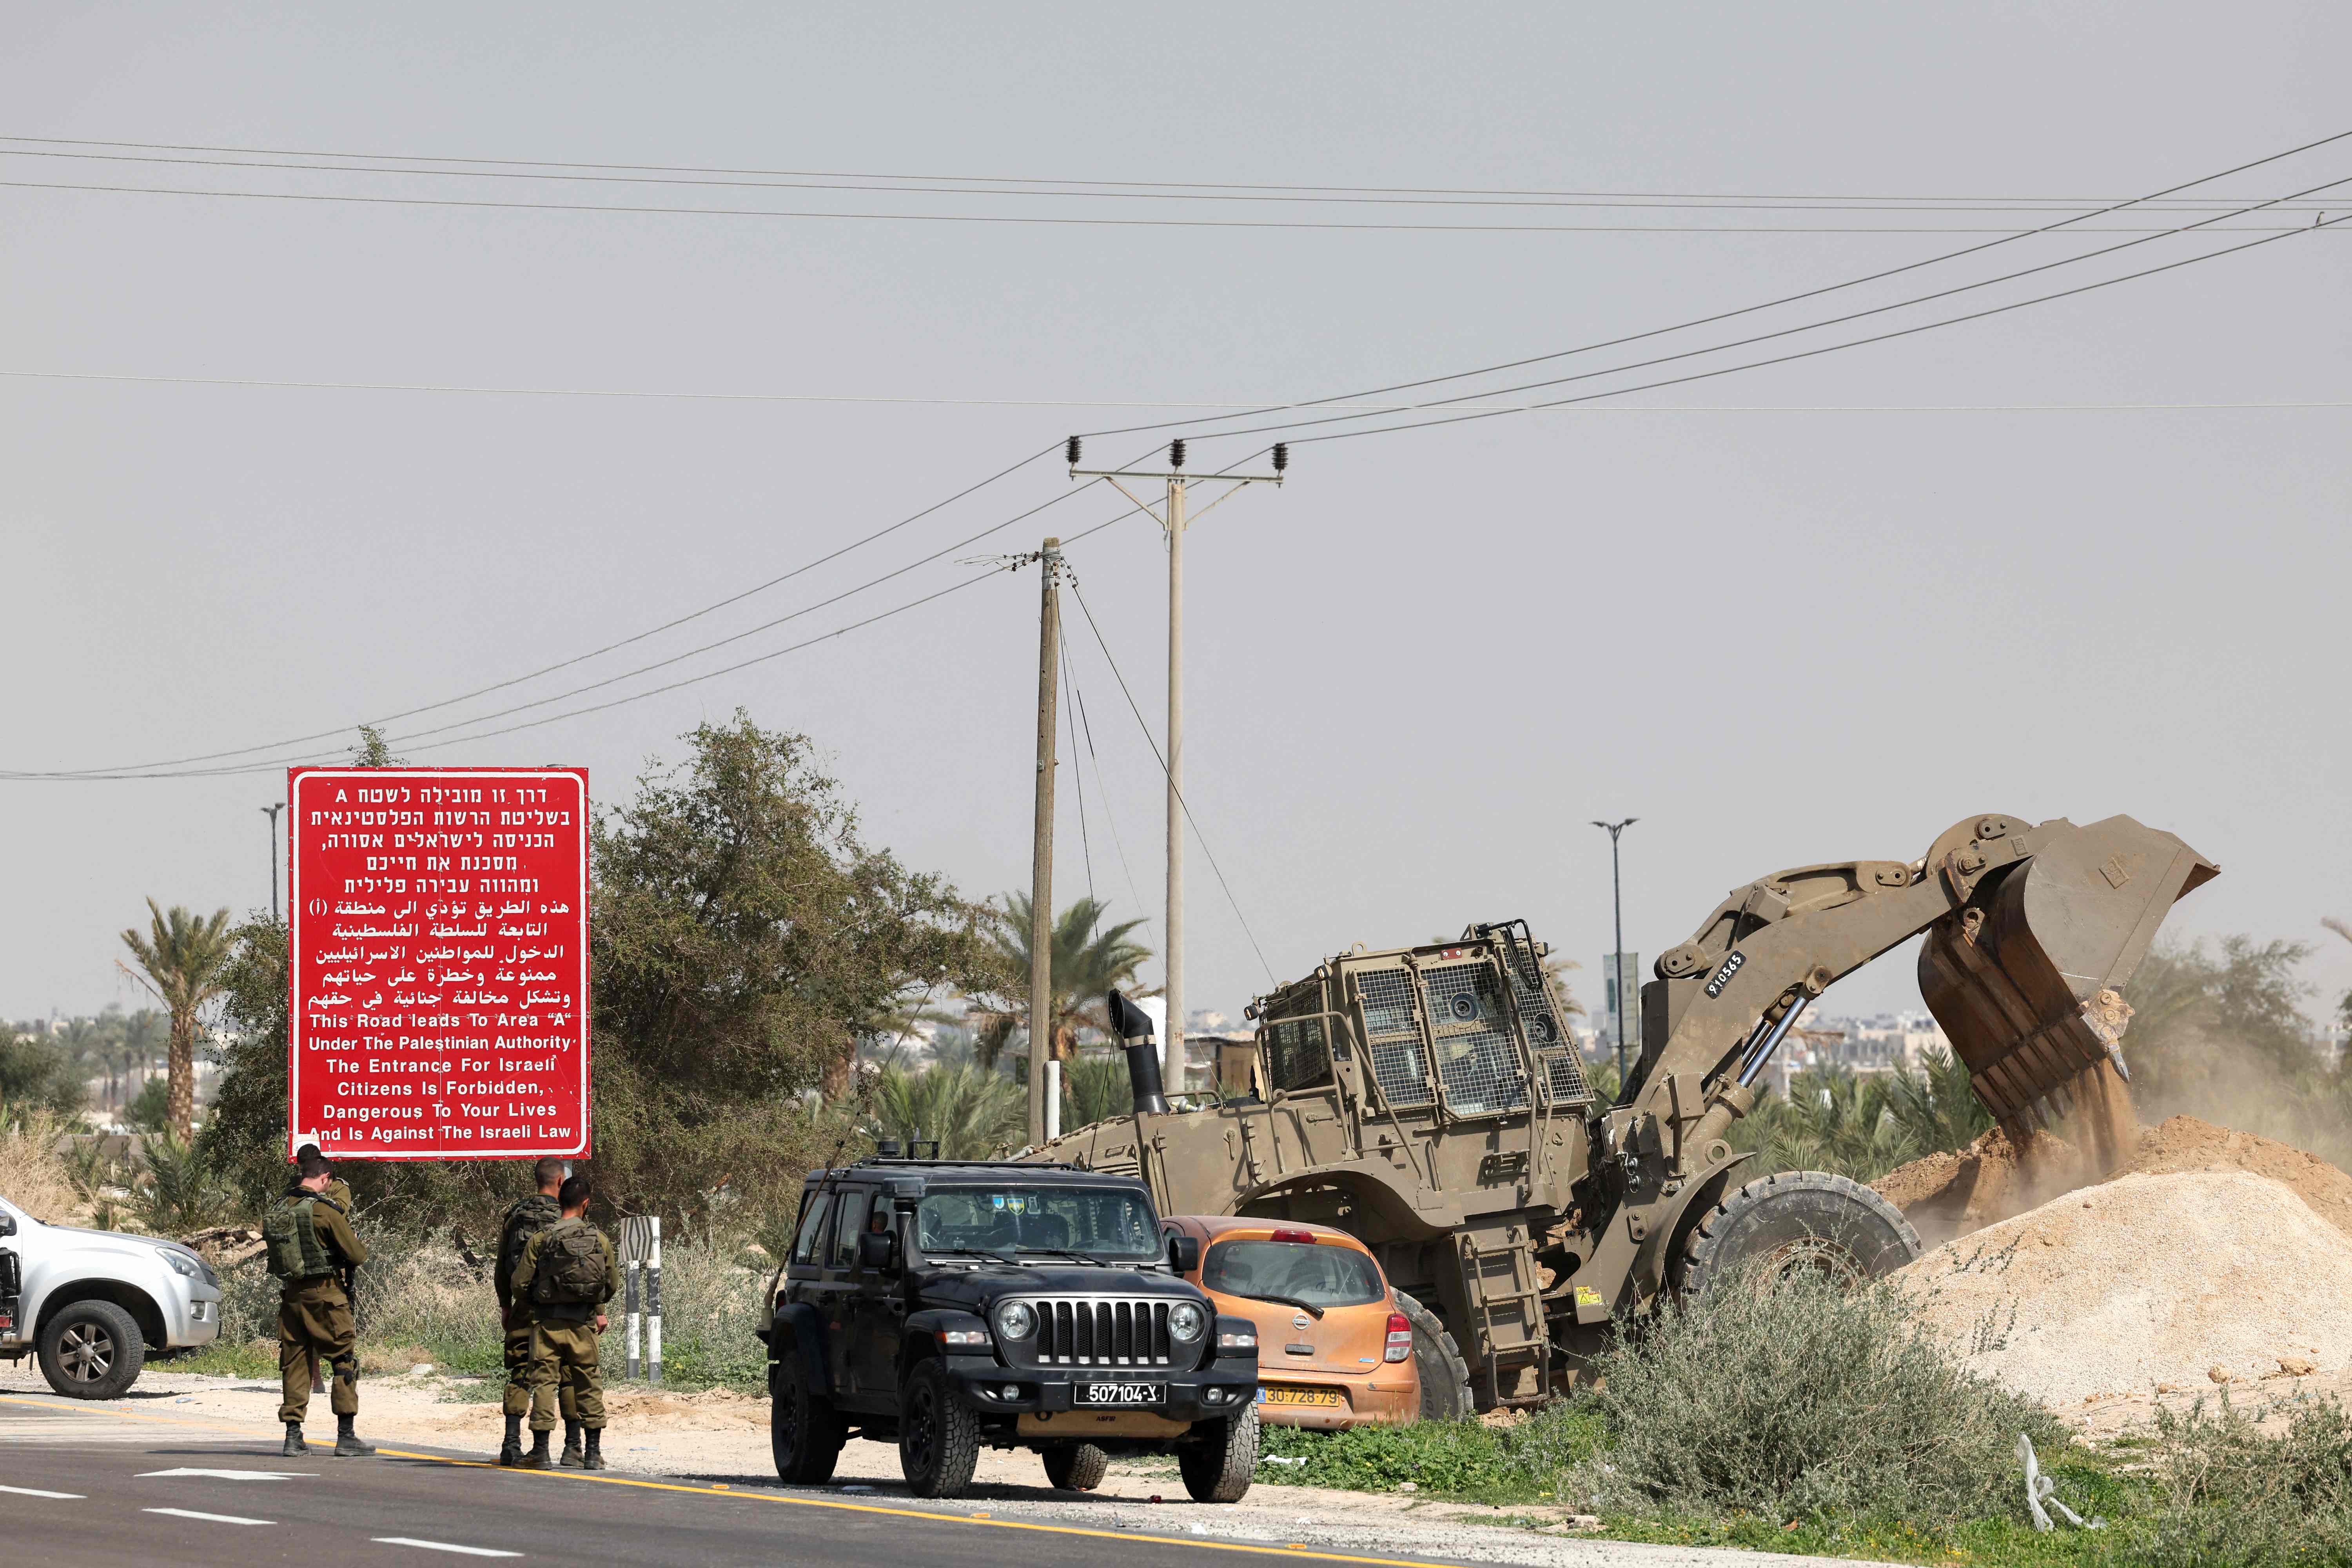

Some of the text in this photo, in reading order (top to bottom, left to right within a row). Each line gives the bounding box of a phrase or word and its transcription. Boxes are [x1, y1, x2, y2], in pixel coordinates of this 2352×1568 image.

[335, 786, 546, 804] דרך זו מובילה לשטח A
[311, 809, 570, 825] בשליטת הרשות הפלסטינאית
[322, 832, 554, 851] הכניסה לישראלים אסורה,
[367, 857, 517, 871] מסכנת את חייכם
[345, 877, 538, 893] ומהווה עבירה פלילית
[334, 901, 386, 915] منطقة
[394, 900, 416, 919] الى
[426, 900, 466, 920] تؤدي
[475, 900, 530, 920] الطريق
[541, 900, 569, 914] هذه
[332, 922, 547, 941] التابعة للسلطة الفلسطينية
[316, 945, 563, 965] الدخول للمواطنين الاسرائيليين
[323, 969, 376, 987] حياتهم
[428, 968, 484, 987] وخطرة
[495, 967, 557, 986] ممنوعة
[1708, 955, 1741, 994] 910565
[308, 990, 570, 1011] وتشكل مخالفة جنائية في حقهم
[309, 1014, 348, 1028] This
[358, 1014, 402, 1027] Road
[412, 1013, 460, 1029] leads
[469, 1013, 488, 1027] To
[497, 1013, 538, 1027] Area
[309, 1035, 571, 1052] Under The Palestinian Authority
[326, 1058, 554, 1073] The Entrance For Israeli
[338, 1080, 543, 1096] Citizens Is Forbidden,
[324, 1103, 556, 1122] Dangerous To Your Lives
[349, 1127, 363, 1140] Is
[371, 1126, 434, 1143] Against
[442, 1125, 472, 1139] The
[481, 1125, 530, 1138] Israeli
[539, 1125, 571, 1138] Law
